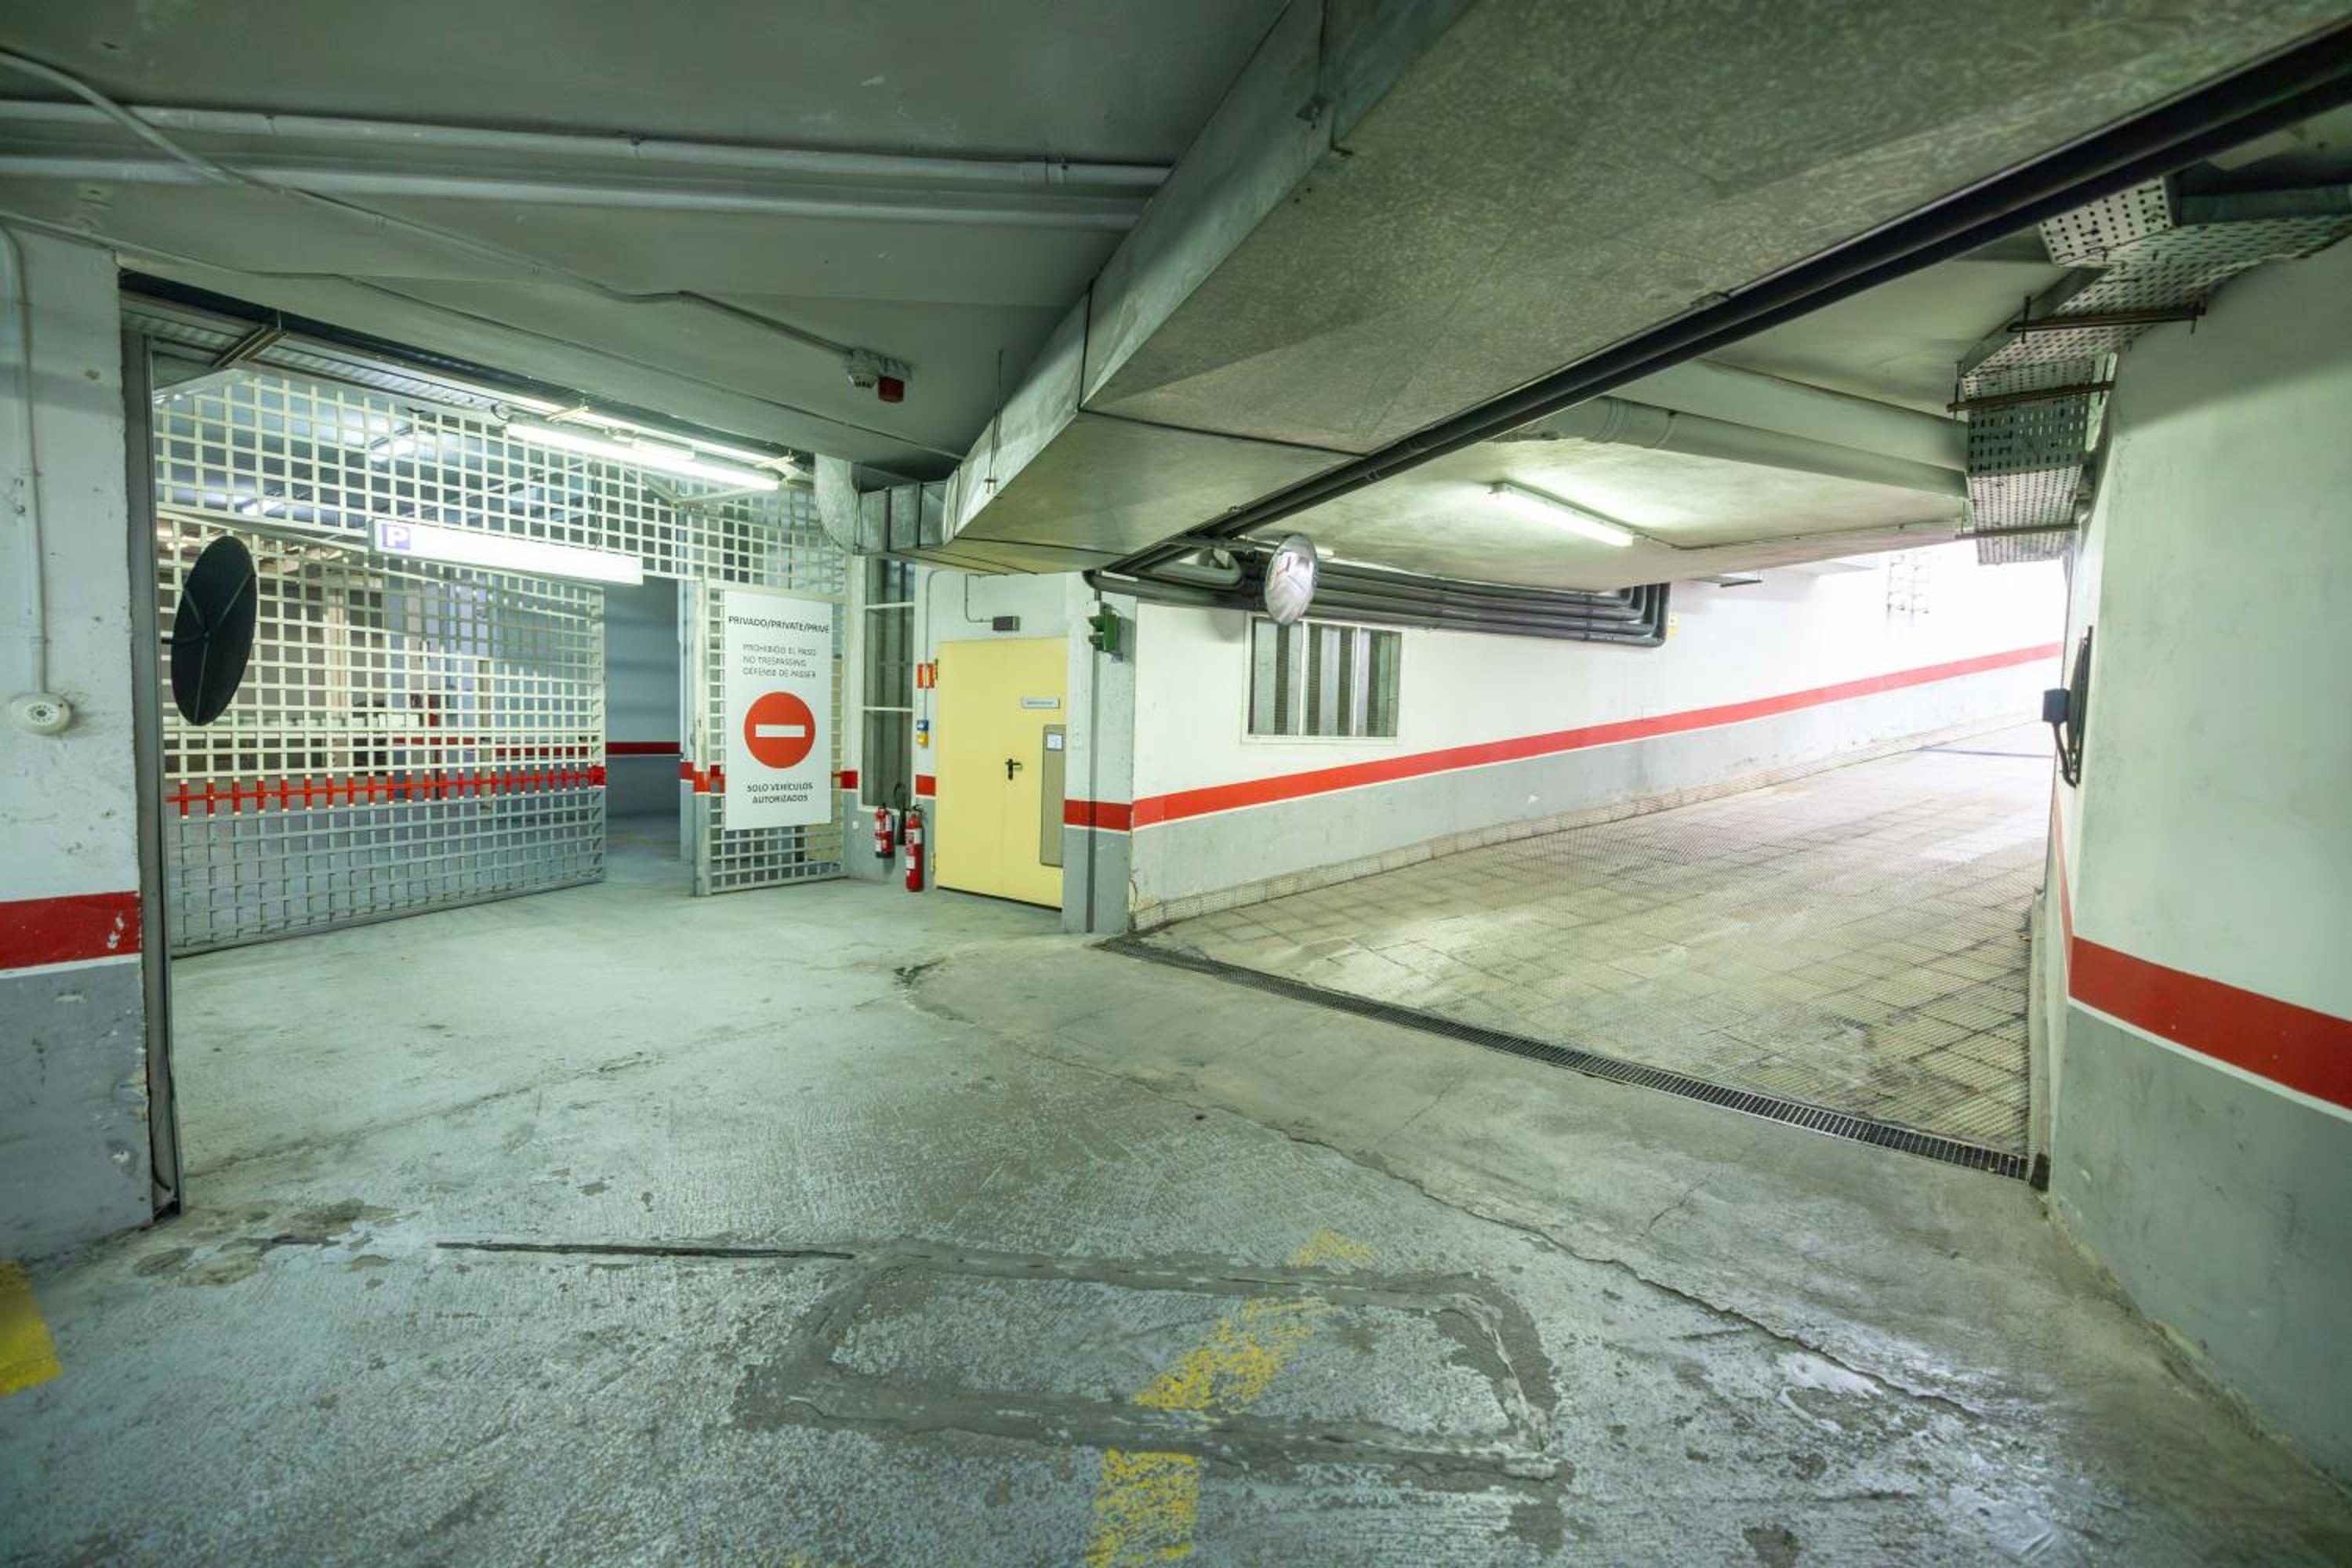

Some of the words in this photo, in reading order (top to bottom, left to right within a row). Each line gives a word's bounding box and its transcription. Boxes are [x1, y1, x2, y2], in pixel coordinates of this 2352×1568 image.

[386, 526, 408, 546] P
[742, 644, 786, 654] PROHIBIDO
[798, 647, 816, 656] PASO
[758, 656, 807, 666] TRESPASSING
[779, 669, 789, 677] DE
[746, 783, 769, 793] SOLO
[753, 793, 808, 804] AUTORIZADOS
